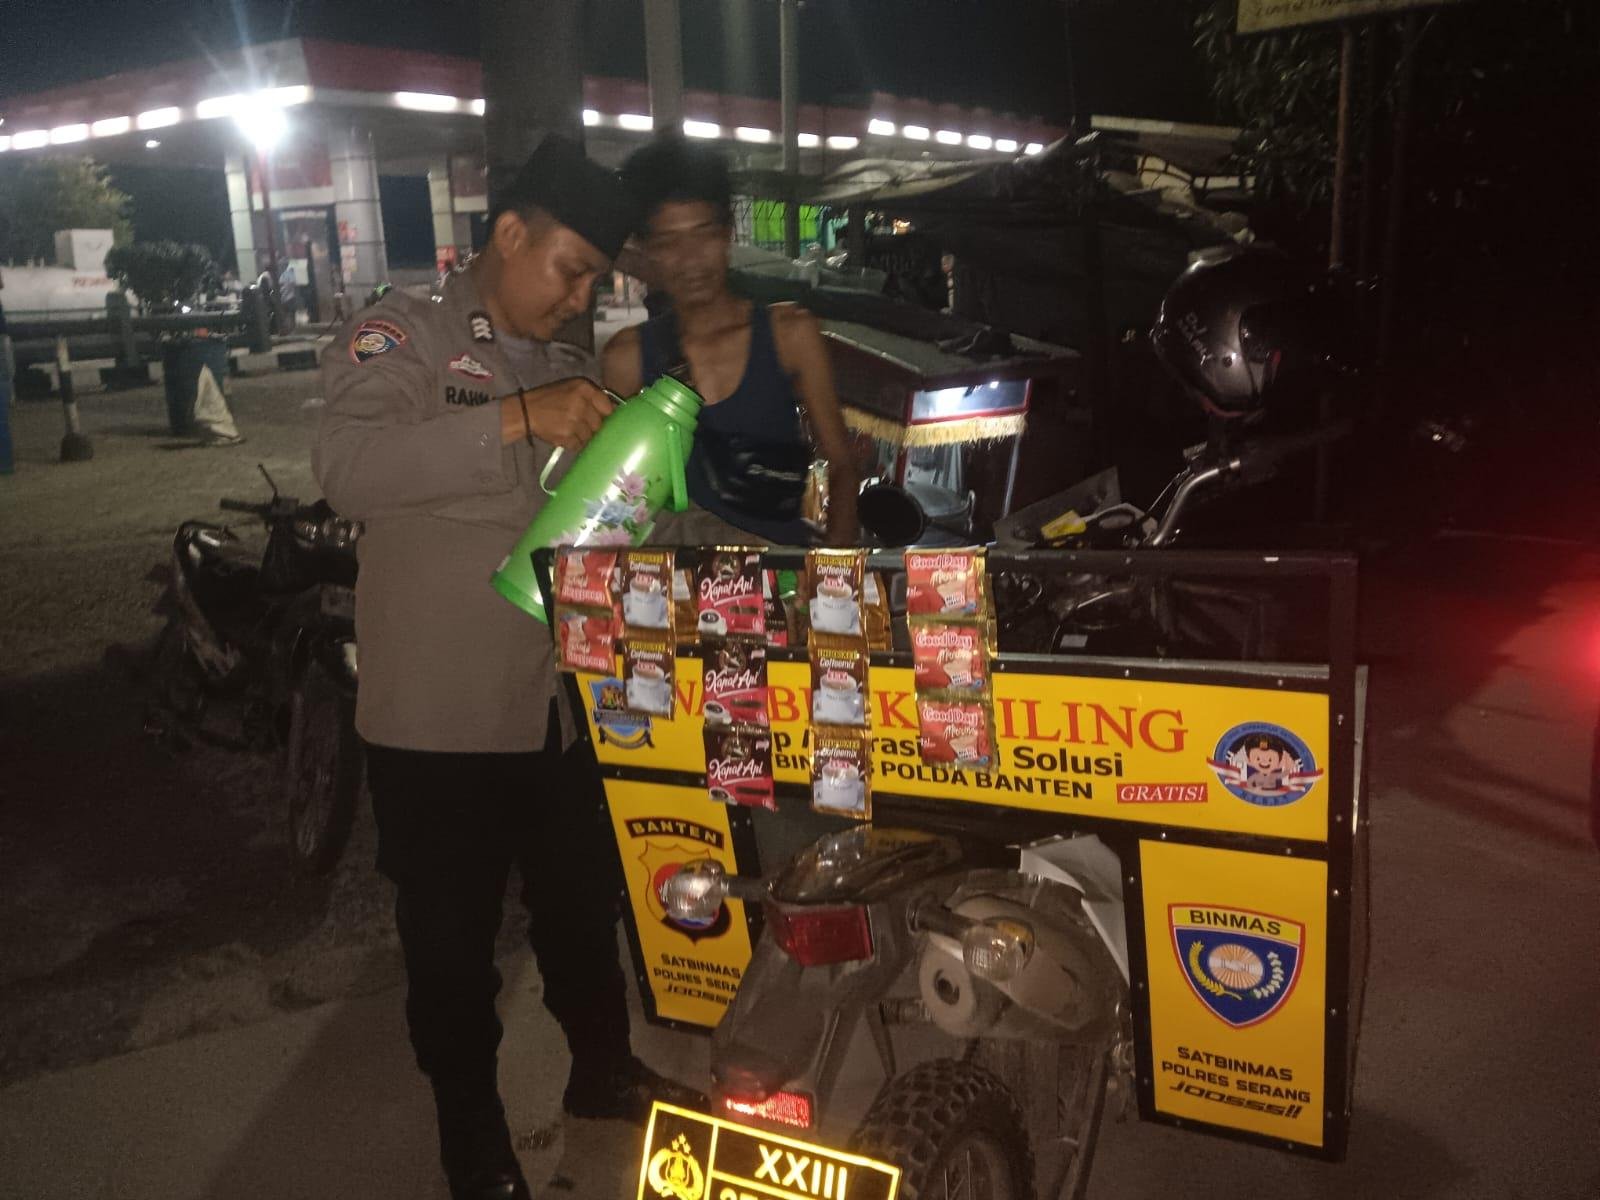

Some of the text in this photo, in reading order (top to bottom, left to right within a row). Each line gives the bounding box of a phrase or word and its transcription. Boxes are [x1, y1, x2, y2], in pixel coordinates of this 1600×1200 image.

[910, 554, 967, 571] Good Day
[701, 573, 753, 600] Kapal Api
[916, 630, 973, 649] Good Day
[705, 667, 758, 692] Kapal Api
[923, 707, 978, 727] Good Day
[709, 755, 741, 781] Kapal
[742, 758, 763, 779] Api
[1014, 746, 1123, 777] Solusi
[881, 761, 968, 788] POLDA
[975, 770, 1093, 800] BANTEN
[1120, 785, 1206, 802] GRATIS!
[632, 819, 717, 844] BANTEN
[1190, 909, 1281, 936] BINMAS
[661, 953, 741, 979] SATBINMAS
[1178, 1046, 1293, 1081] SATBINMAS
[1162, 1060, 1310, 1103] POLRES SERANG
[755, 1144, 848, 1200] XXIII
